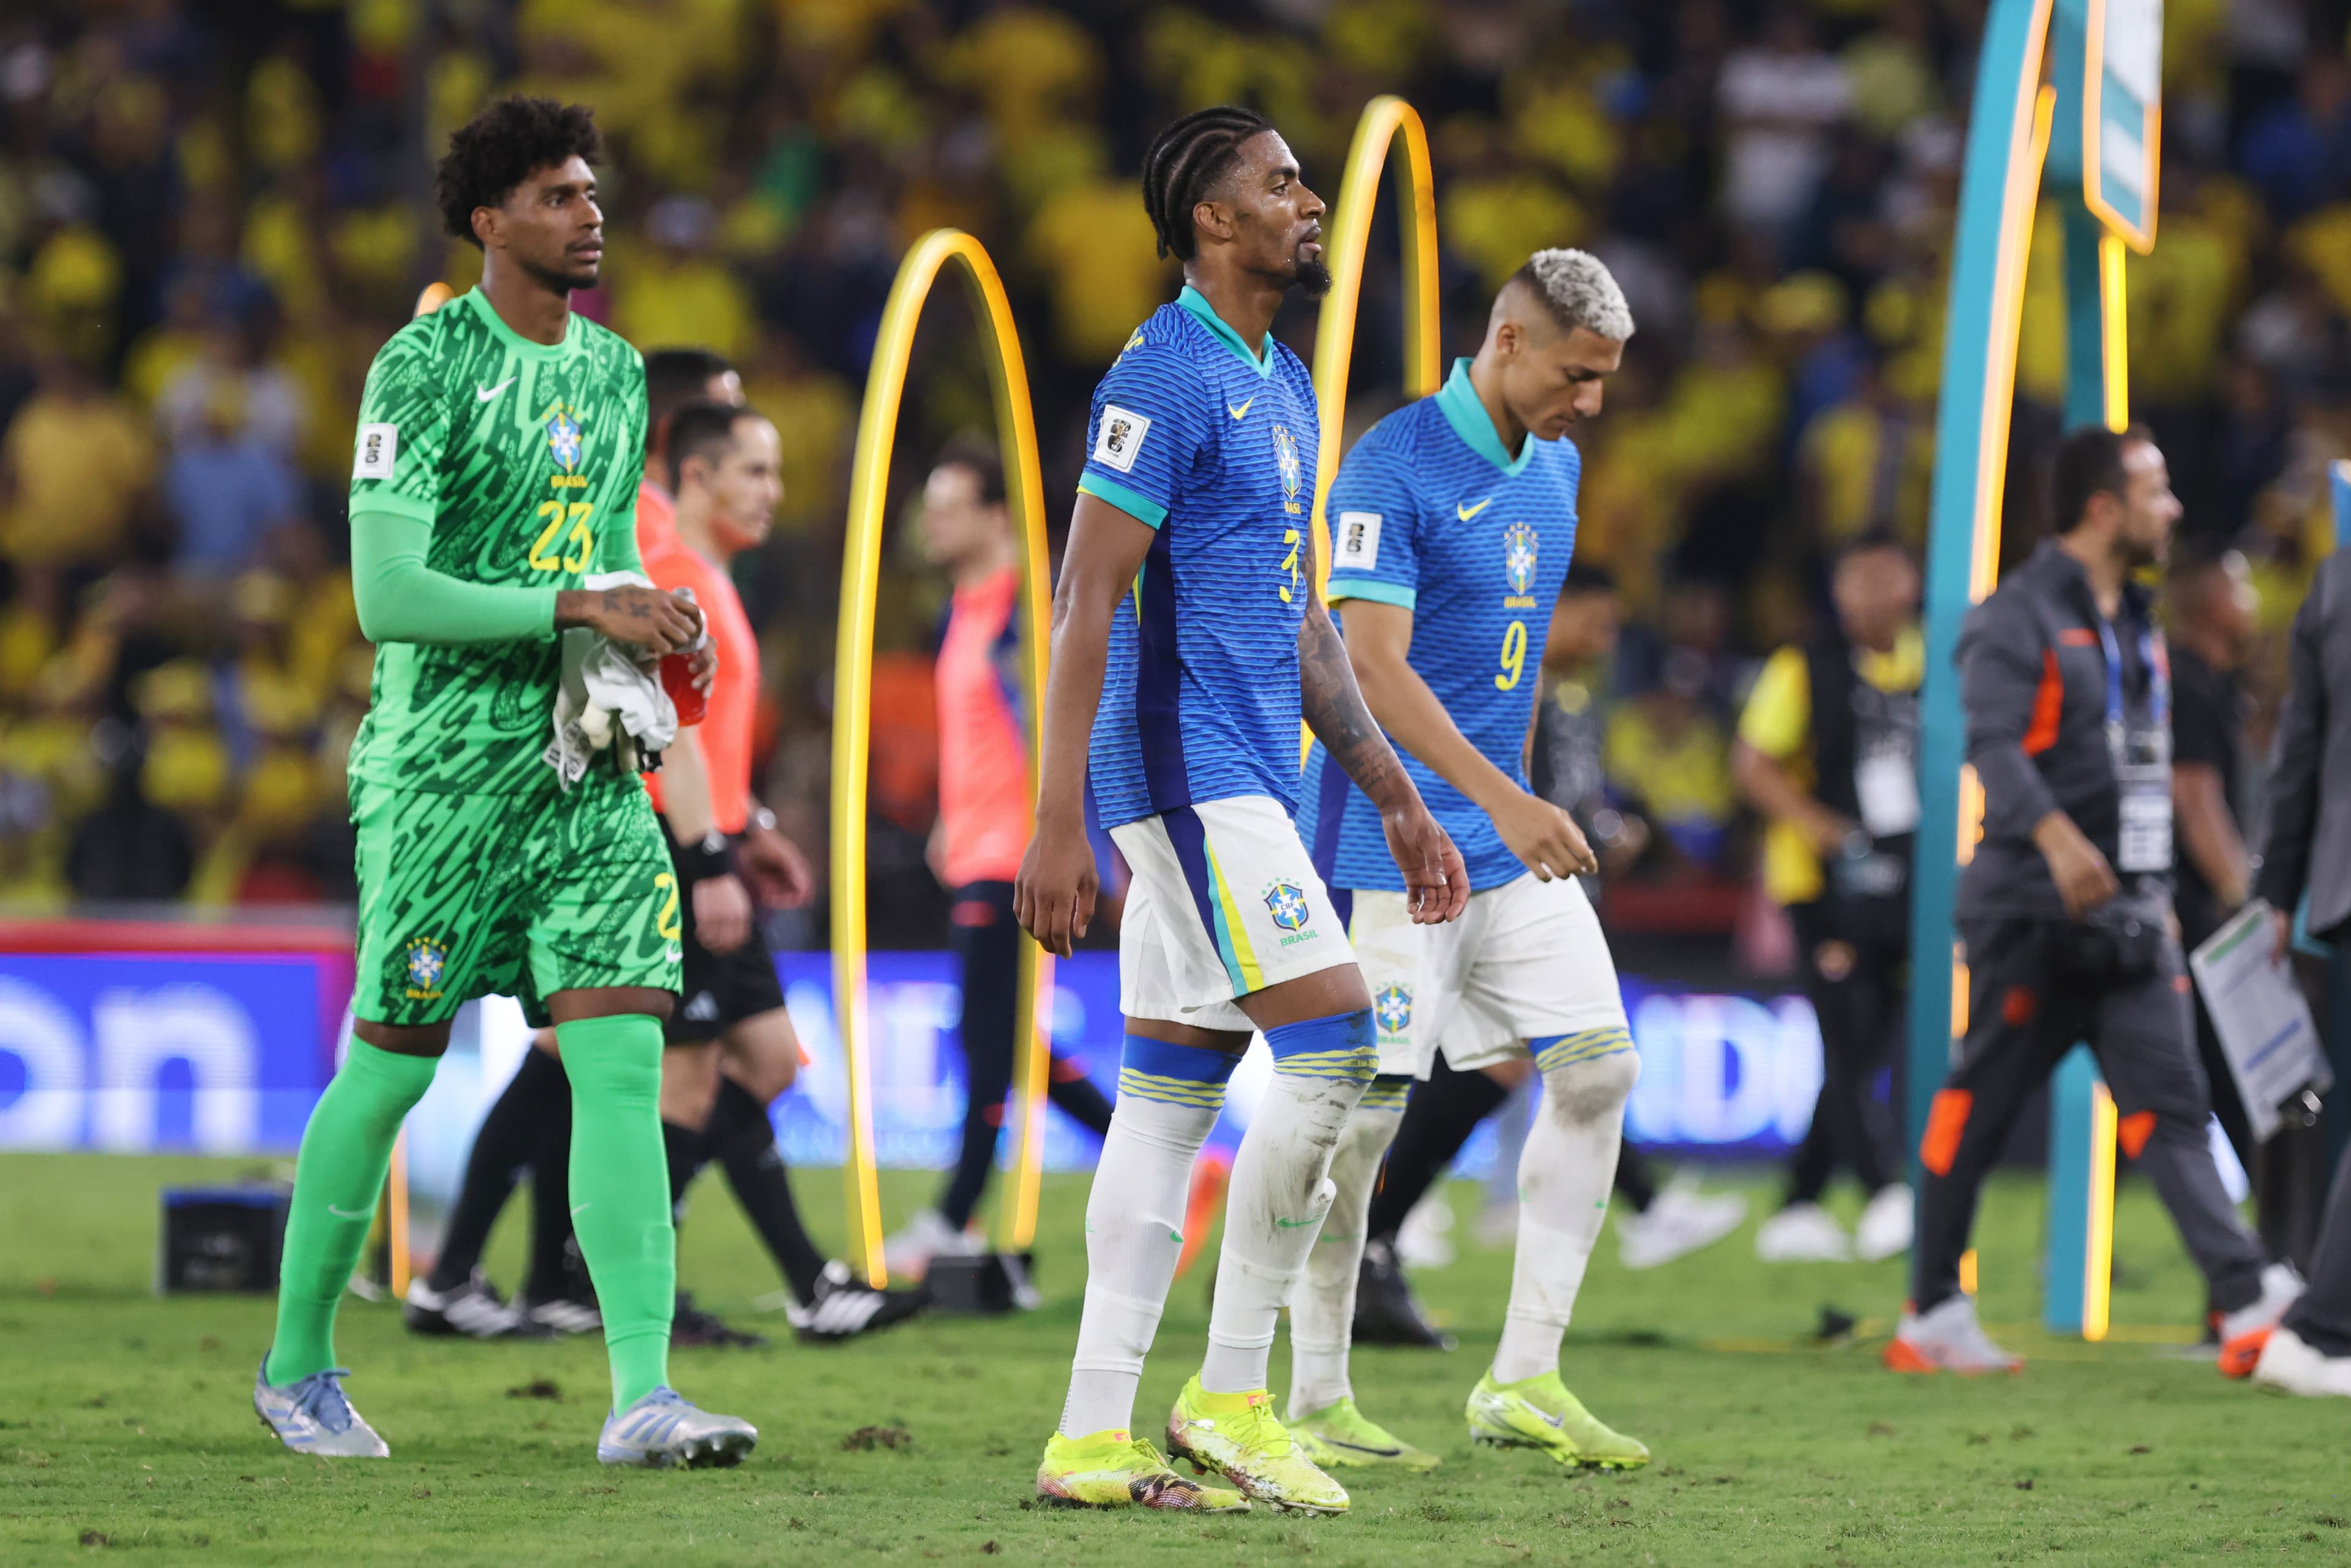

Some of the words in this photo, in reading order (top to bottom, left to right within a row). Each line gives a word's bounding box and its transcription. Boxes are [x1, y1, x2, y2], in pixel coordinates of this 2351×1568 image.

[551, 475, 588, 488] BRASIL
[528, 500, 593, 573] 23
[1279, 529, 1300, 603] 3
[1494, 621, 1528, 691] 9
[1280, 902, 1295, 910] CBF
[1280, 930, 1319, 947] BRASIL
